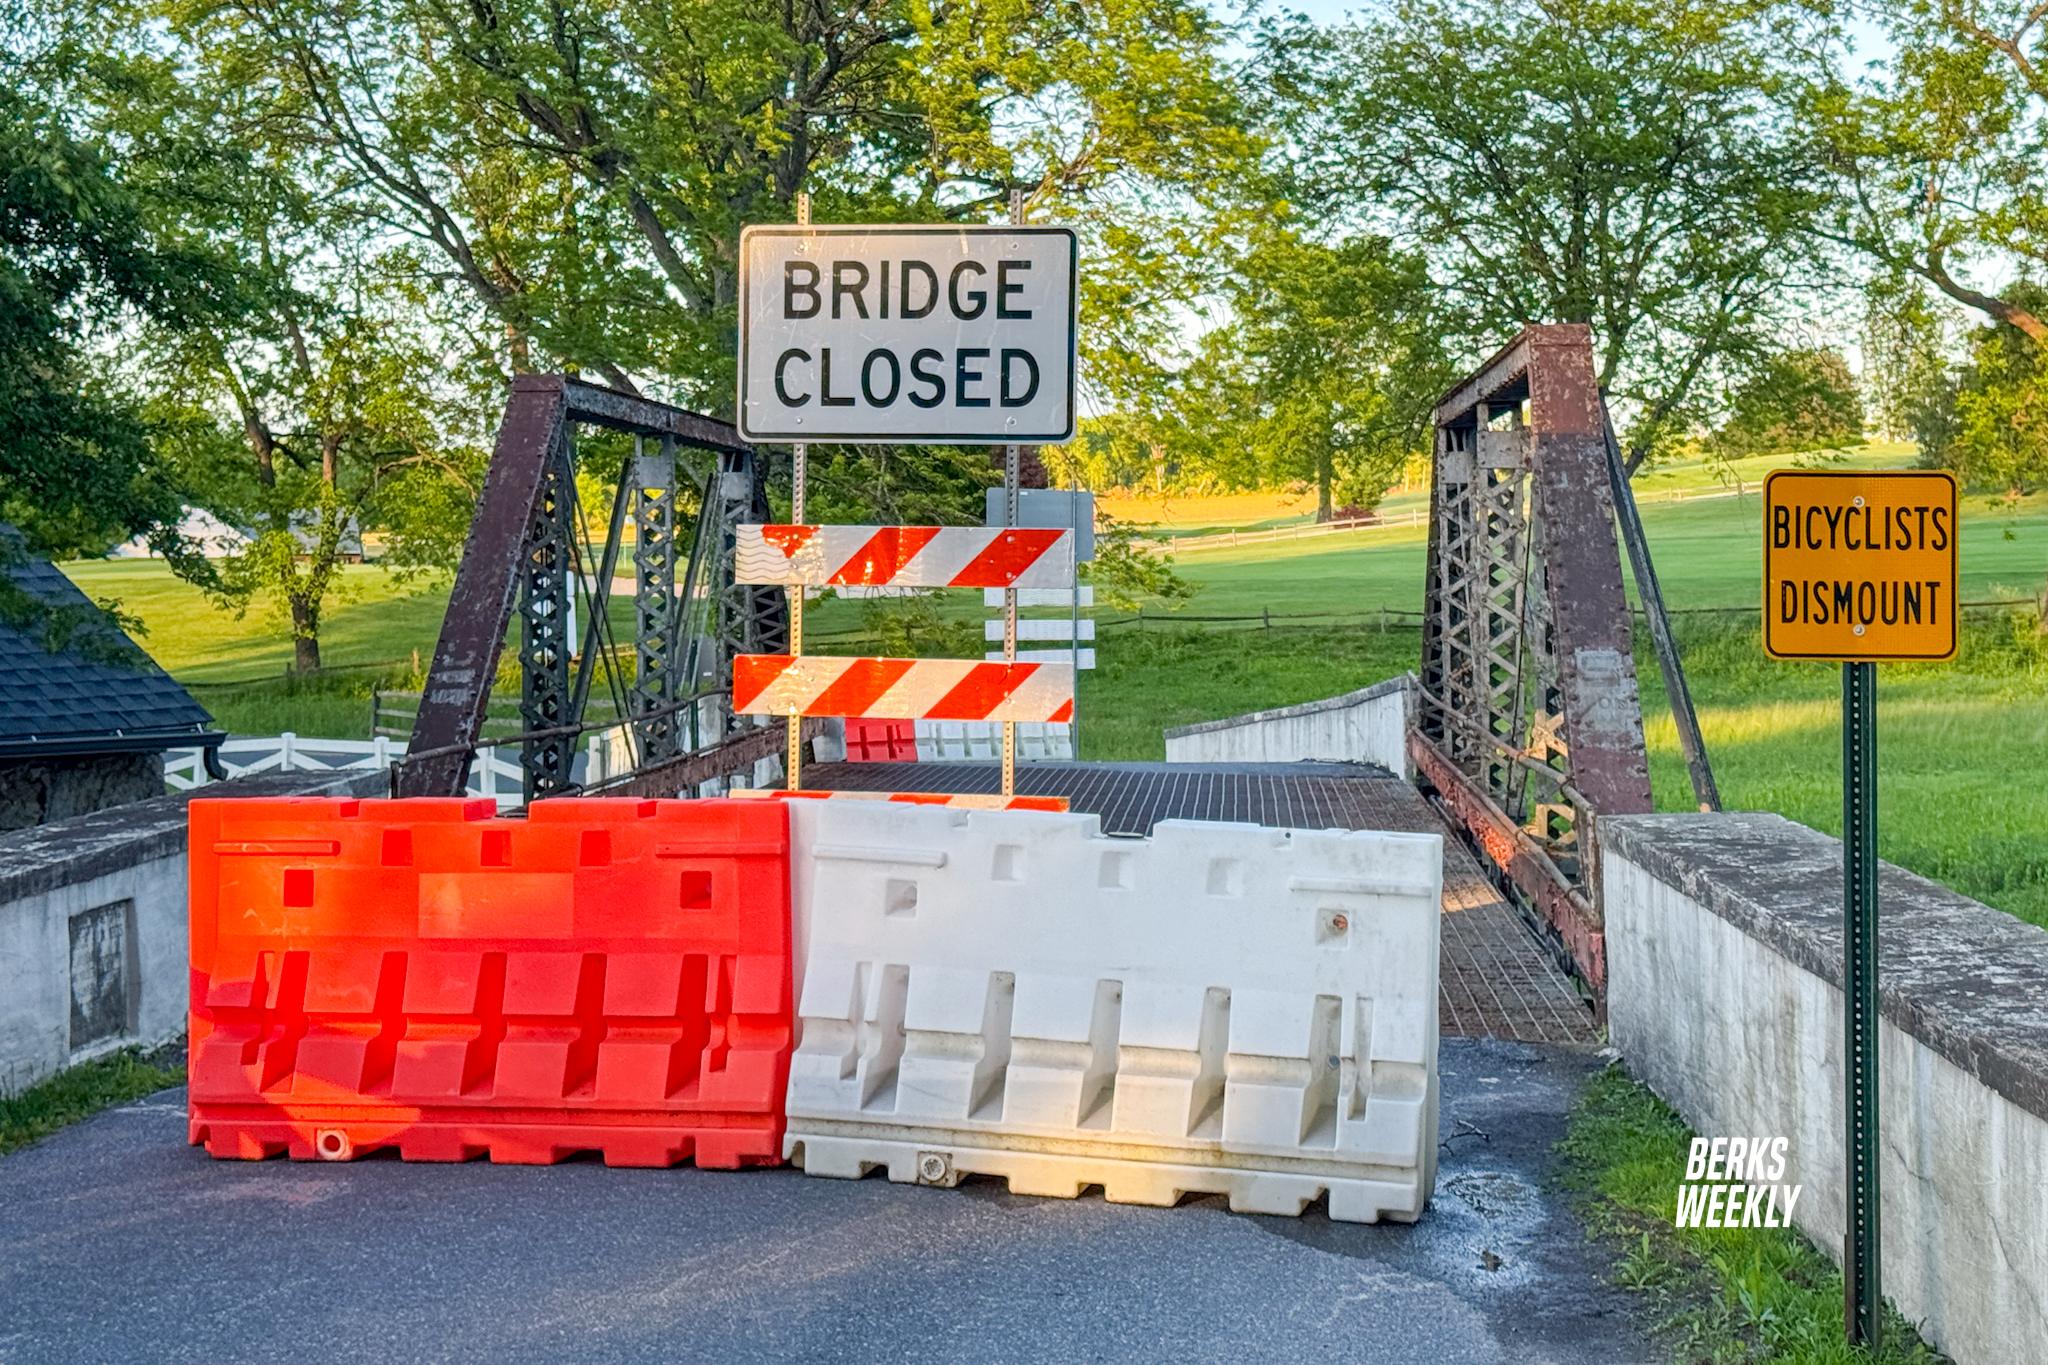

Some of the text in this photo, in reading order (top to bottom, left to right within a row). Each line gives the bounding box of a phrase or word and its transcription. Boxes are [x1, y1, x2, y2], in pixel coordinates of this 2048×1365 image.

[784, 260, 1033, 320] BRIDGE
[775, 347, 1040, 408] CLOSED
[1773, 505, 1948, 551] BICYCLISTS
[1781, 580, 1941, 625] DISMOUNT
